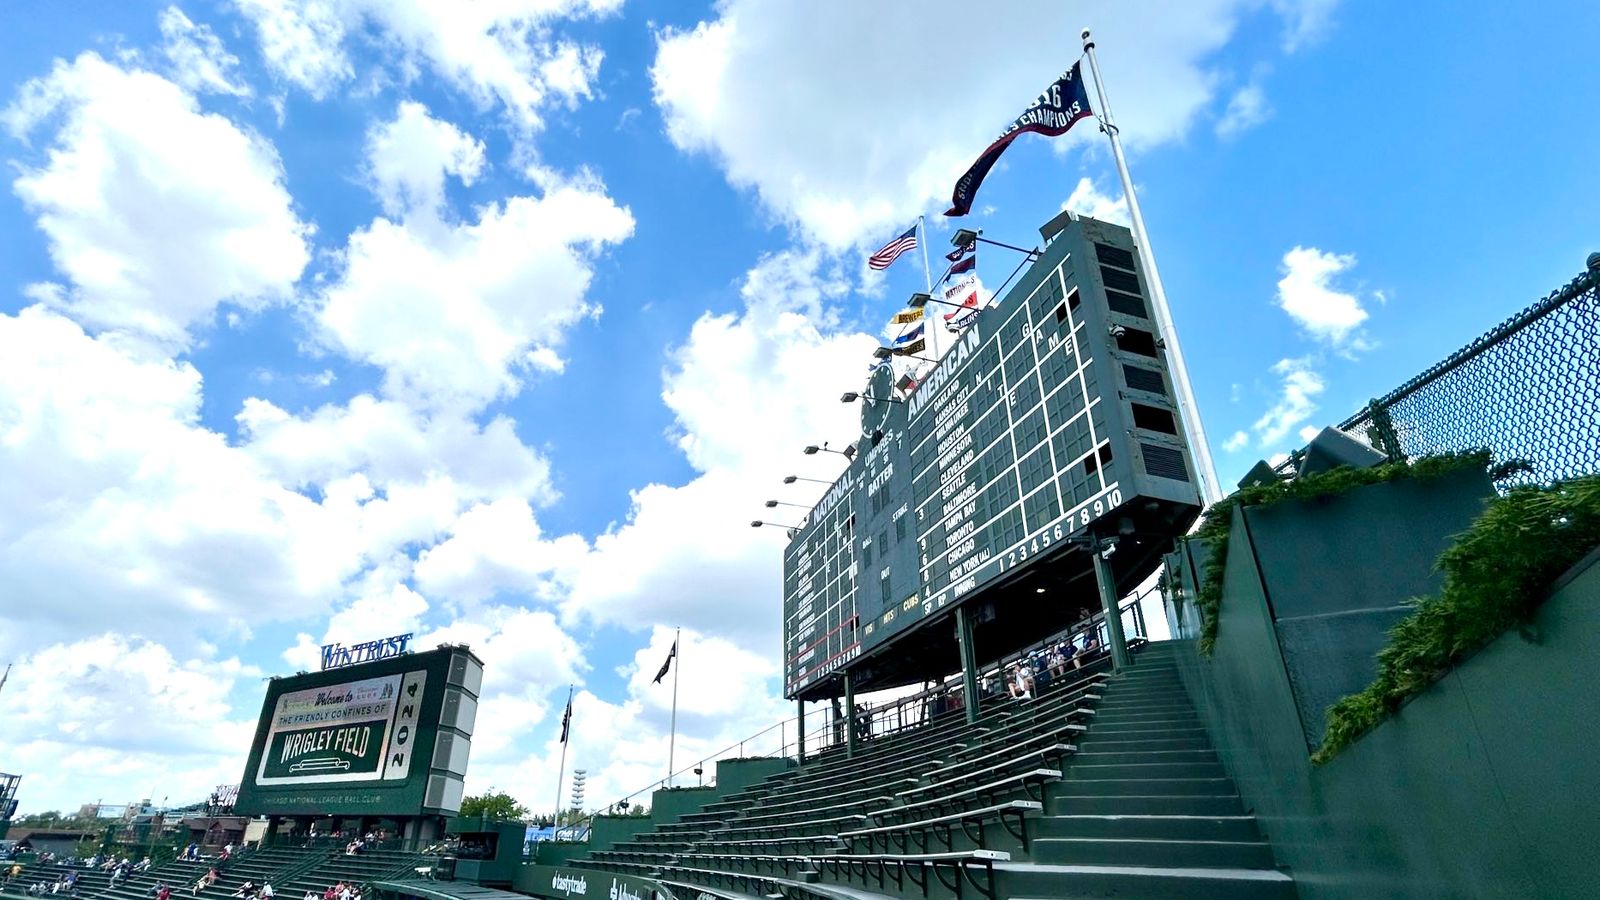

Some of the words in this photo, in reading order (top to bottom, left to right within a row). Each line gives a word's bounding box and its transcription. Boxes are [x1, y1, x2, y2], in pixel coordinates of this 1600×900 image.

[1020, 100, 1081, 128] CHAMPIONS
[907, 323, 981, 421] AMERICAN
[933, 378, 960, 412] OAKLAND
[935, 399, 956, 427] KANSAS
[956, 384, 970, 405] CITY
[865, 428, 893, 467] UMPIRES
[937, 422, 965, 456] HOUSTON
[939, 433, 972, 471] MINNESOTA
[868, 462, 893, 498] BATTER
[940, 449, 974, 487] CLEVELAND
[813, 469, 854, 527] NATIONAL
[942, 474, 967, 500] SEATTLE
[943, 481, 977, 518] BALTIMORE
[892, 502, 908, 523] STRIKE
[919, 508, 924, 520] 3
[944, 508, 964, 532] TAMPA
[964, 499, 977, 518] BAY
[946, 521, 975, 550] TORONTO
[922, 554, 927, 566] 6
[925, 602, 932, 615] SP
[1008, 554, 1015, 567] 2
[1019, 547, 1027, 560] 3
[1031, 541, 1038, 554] 4
[1042, 534, 1050, 547] 5
[1054, 526, 1062, 540] 6
[1067, 519, 1074, 534] 7
[1080, 511, 1089, 526] 8
[1094, 504, 1103, 518] 9
[1106, 489, 1122, 511] 10
[947, 539, 975, 567] CHICAGO
[923, 569, 929, 582] 8
[950, 562, 963, 583] NEW
[903, 593, 919, 612] CUBS
[925, 585, 931, 597] 4
[315, 690, 345, 707] Welcome
[280, 715, 293, 726] THE
[295, 710, 328, 723] FRIENDLY
[331, 705, 371, 720] CONFINES
[374, 704, 386, 715] OF
[281, 729, 334, 764] WRIGLEY
[335, 726, 371, 758] FIELD
[557, 875, 587, 896] tastytrade
